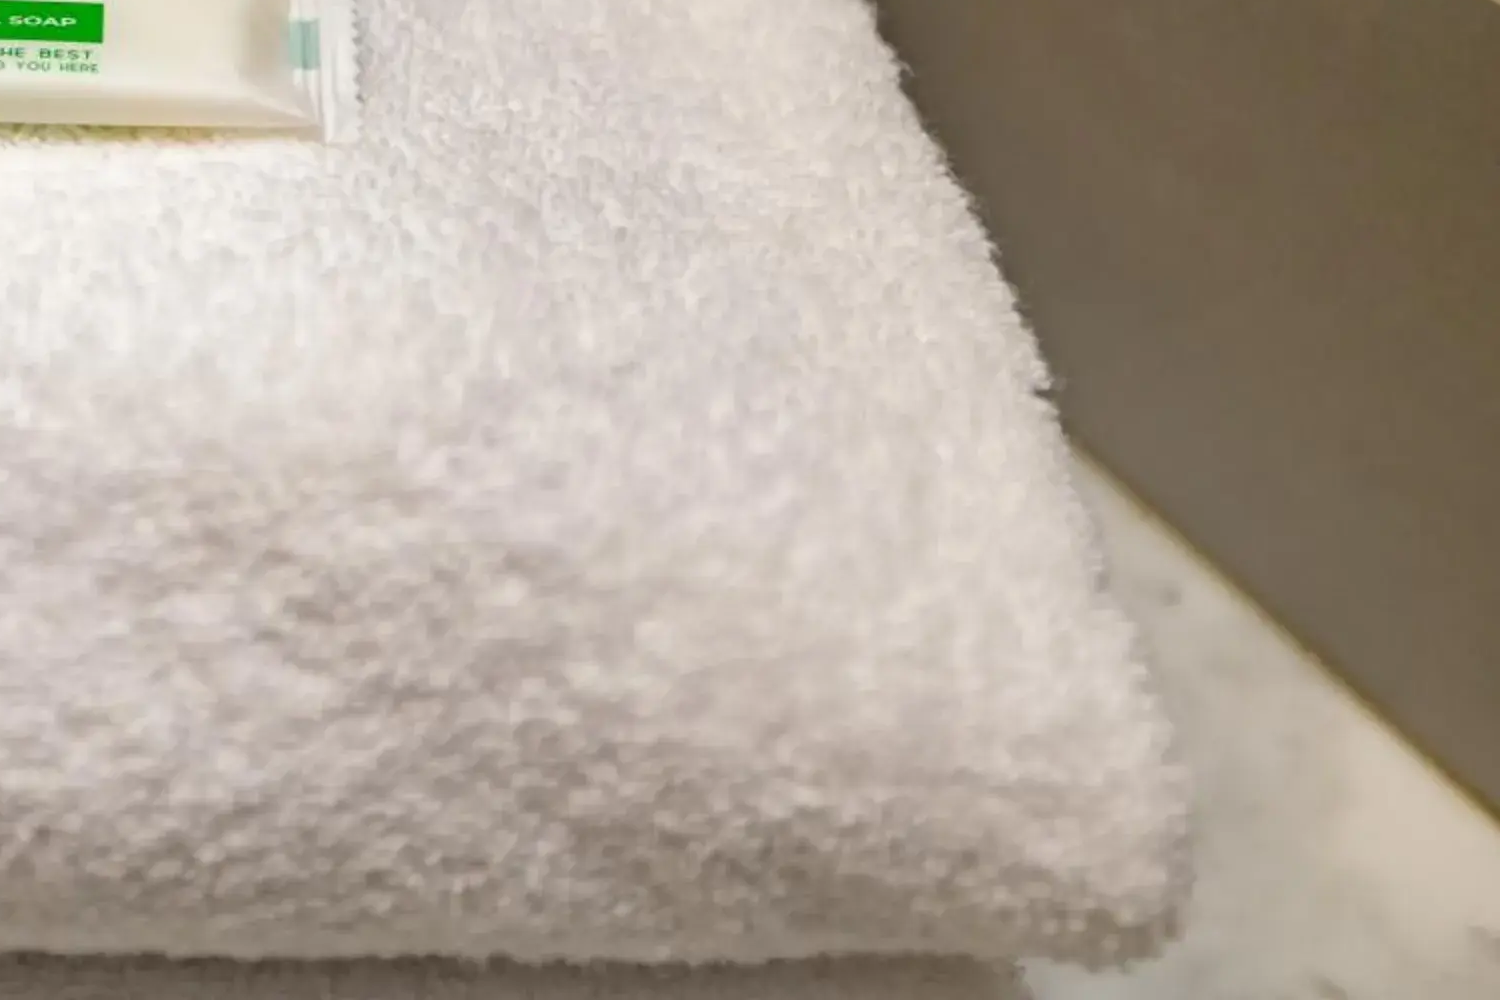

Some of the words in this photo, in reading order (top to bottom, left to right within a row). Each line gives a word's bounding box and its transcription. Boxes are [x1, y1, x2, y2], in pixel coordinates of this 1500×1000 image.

[8, 15, 77, 27] SOAP
[39, 48, 93, 60] BEST
[16, 60, 51, 72] YOU
[59, 62, 99, 74] HERE
